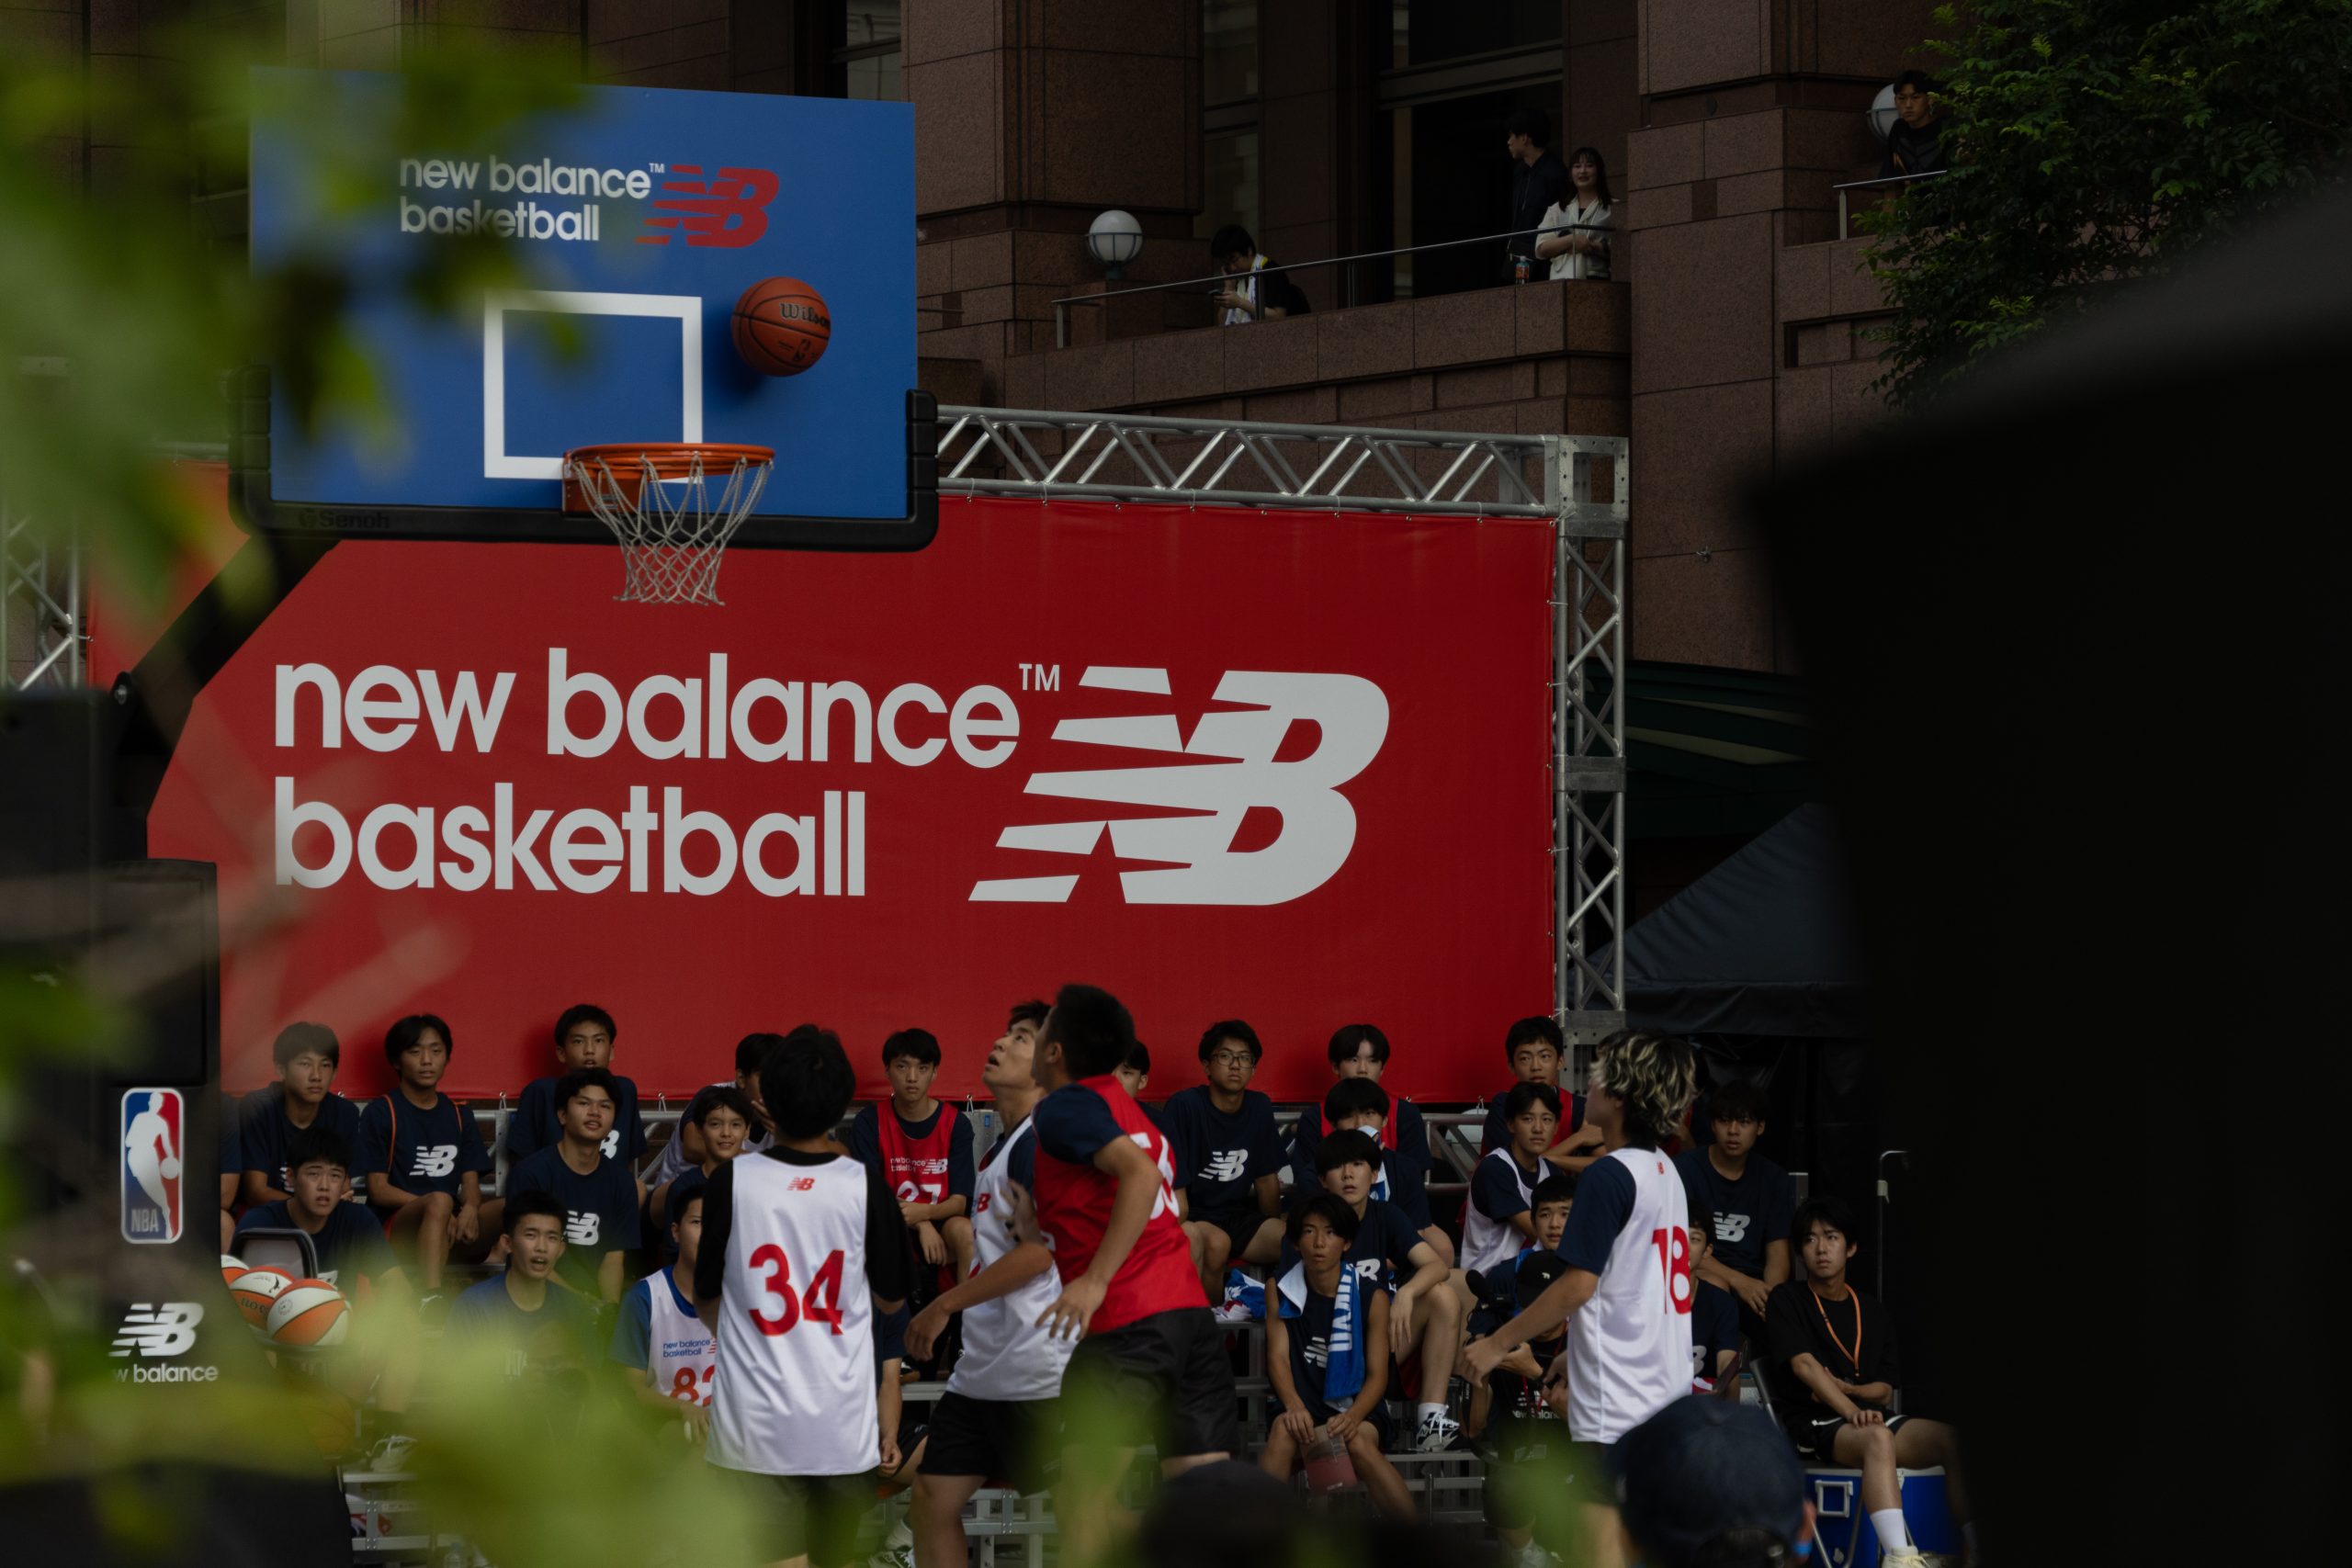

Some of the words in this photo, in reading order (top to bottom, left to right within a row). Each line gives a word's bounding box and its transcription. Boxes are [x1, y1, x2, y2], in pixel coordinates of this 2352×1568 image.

[401, 158, 480, 189] new
[490, 155, 650, 199] balance
[401, 196, 600, 242] basketball
[634, 164, 780, 248] NB
[320, 511, 390, 530] Senoh
[275, 663, 516, 753] new
[548, 648, 1020, 769] balance
[968, 665, 1390, 906] NB
[275, 776, 865, 897] basketball
[130, 1209, 160, 1233] NBA
[750, 1244, 844, 1336] 34
[1652, 1226, 1692, 1314] 18
[662, 1348, 702, 1358] basketball
[679, 1339, 711, 1348] balance
[133, 1363, 219, 1382] balance
